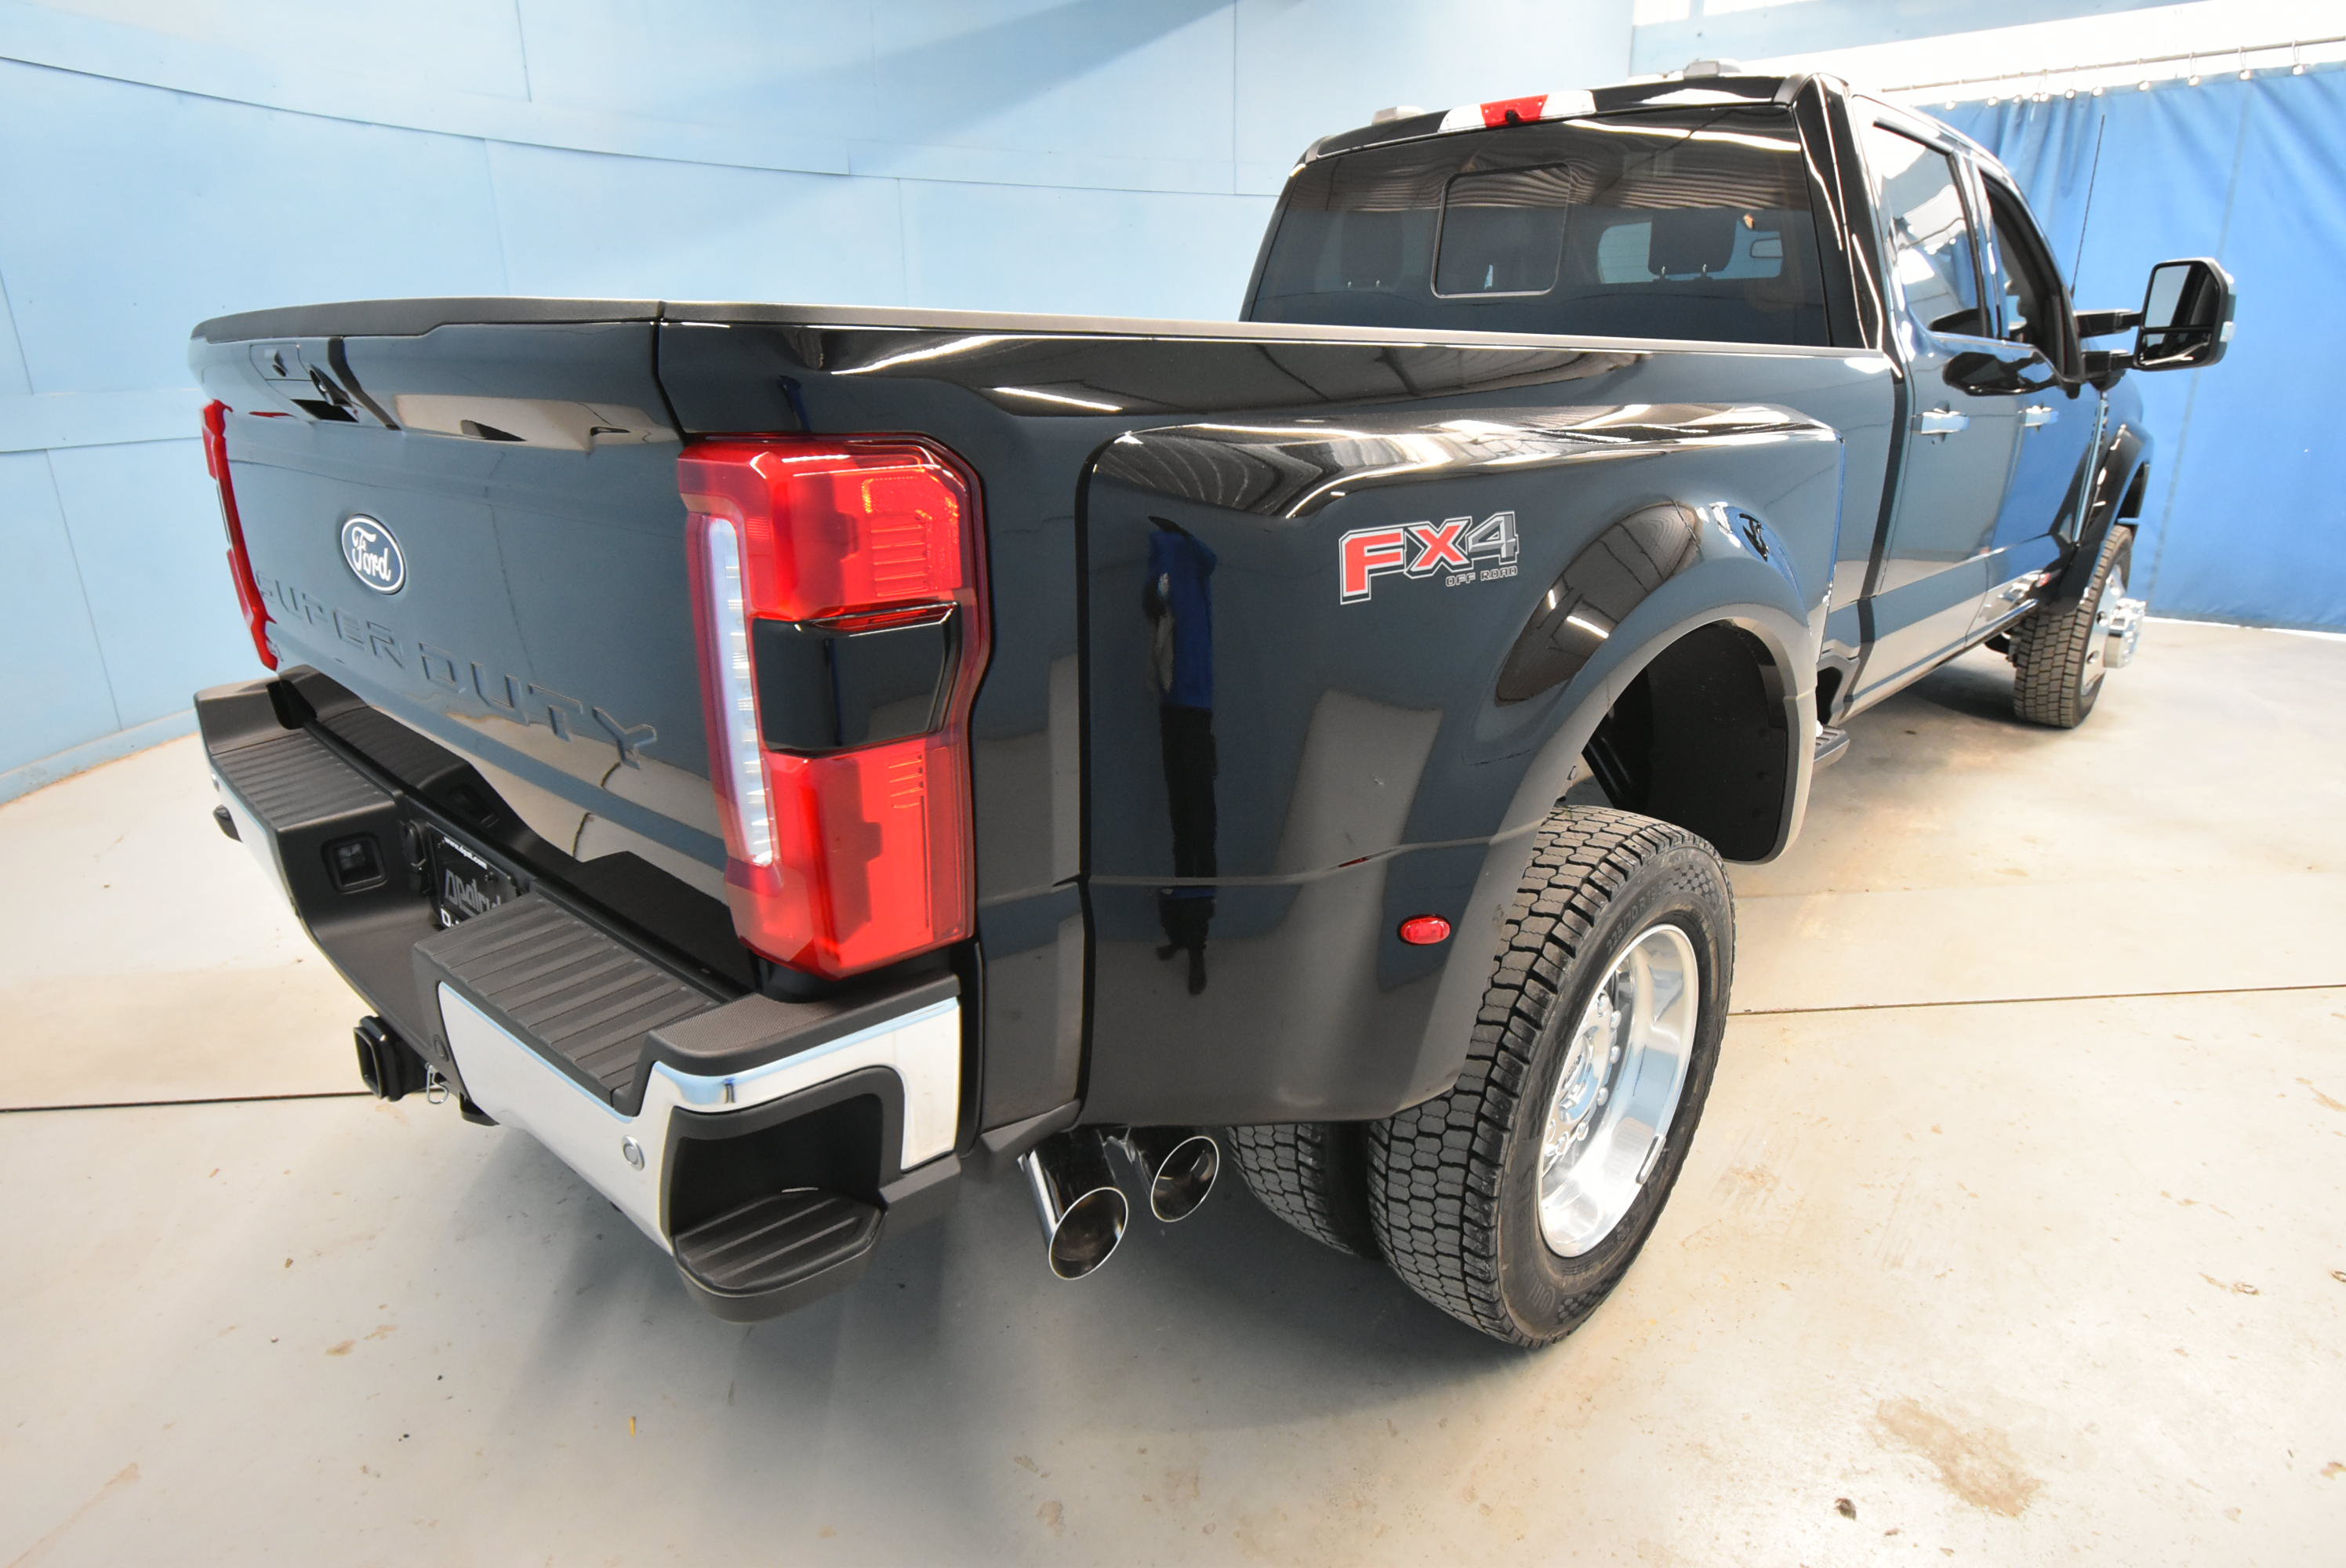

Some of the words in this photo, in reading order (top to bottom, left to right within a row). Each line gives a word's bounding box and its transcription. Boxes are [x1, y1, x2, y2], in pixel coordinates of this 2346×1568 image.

[351, 526, 391, 582] Ford
[1338, 511, 1519, 604] FX4
[1446, 572, 1476, 587] OFF
[1480, 565, 1518, 581] ROAD
[256, 570, 406, 668] SUPER
[418, 641, 658, 770] DUTY
